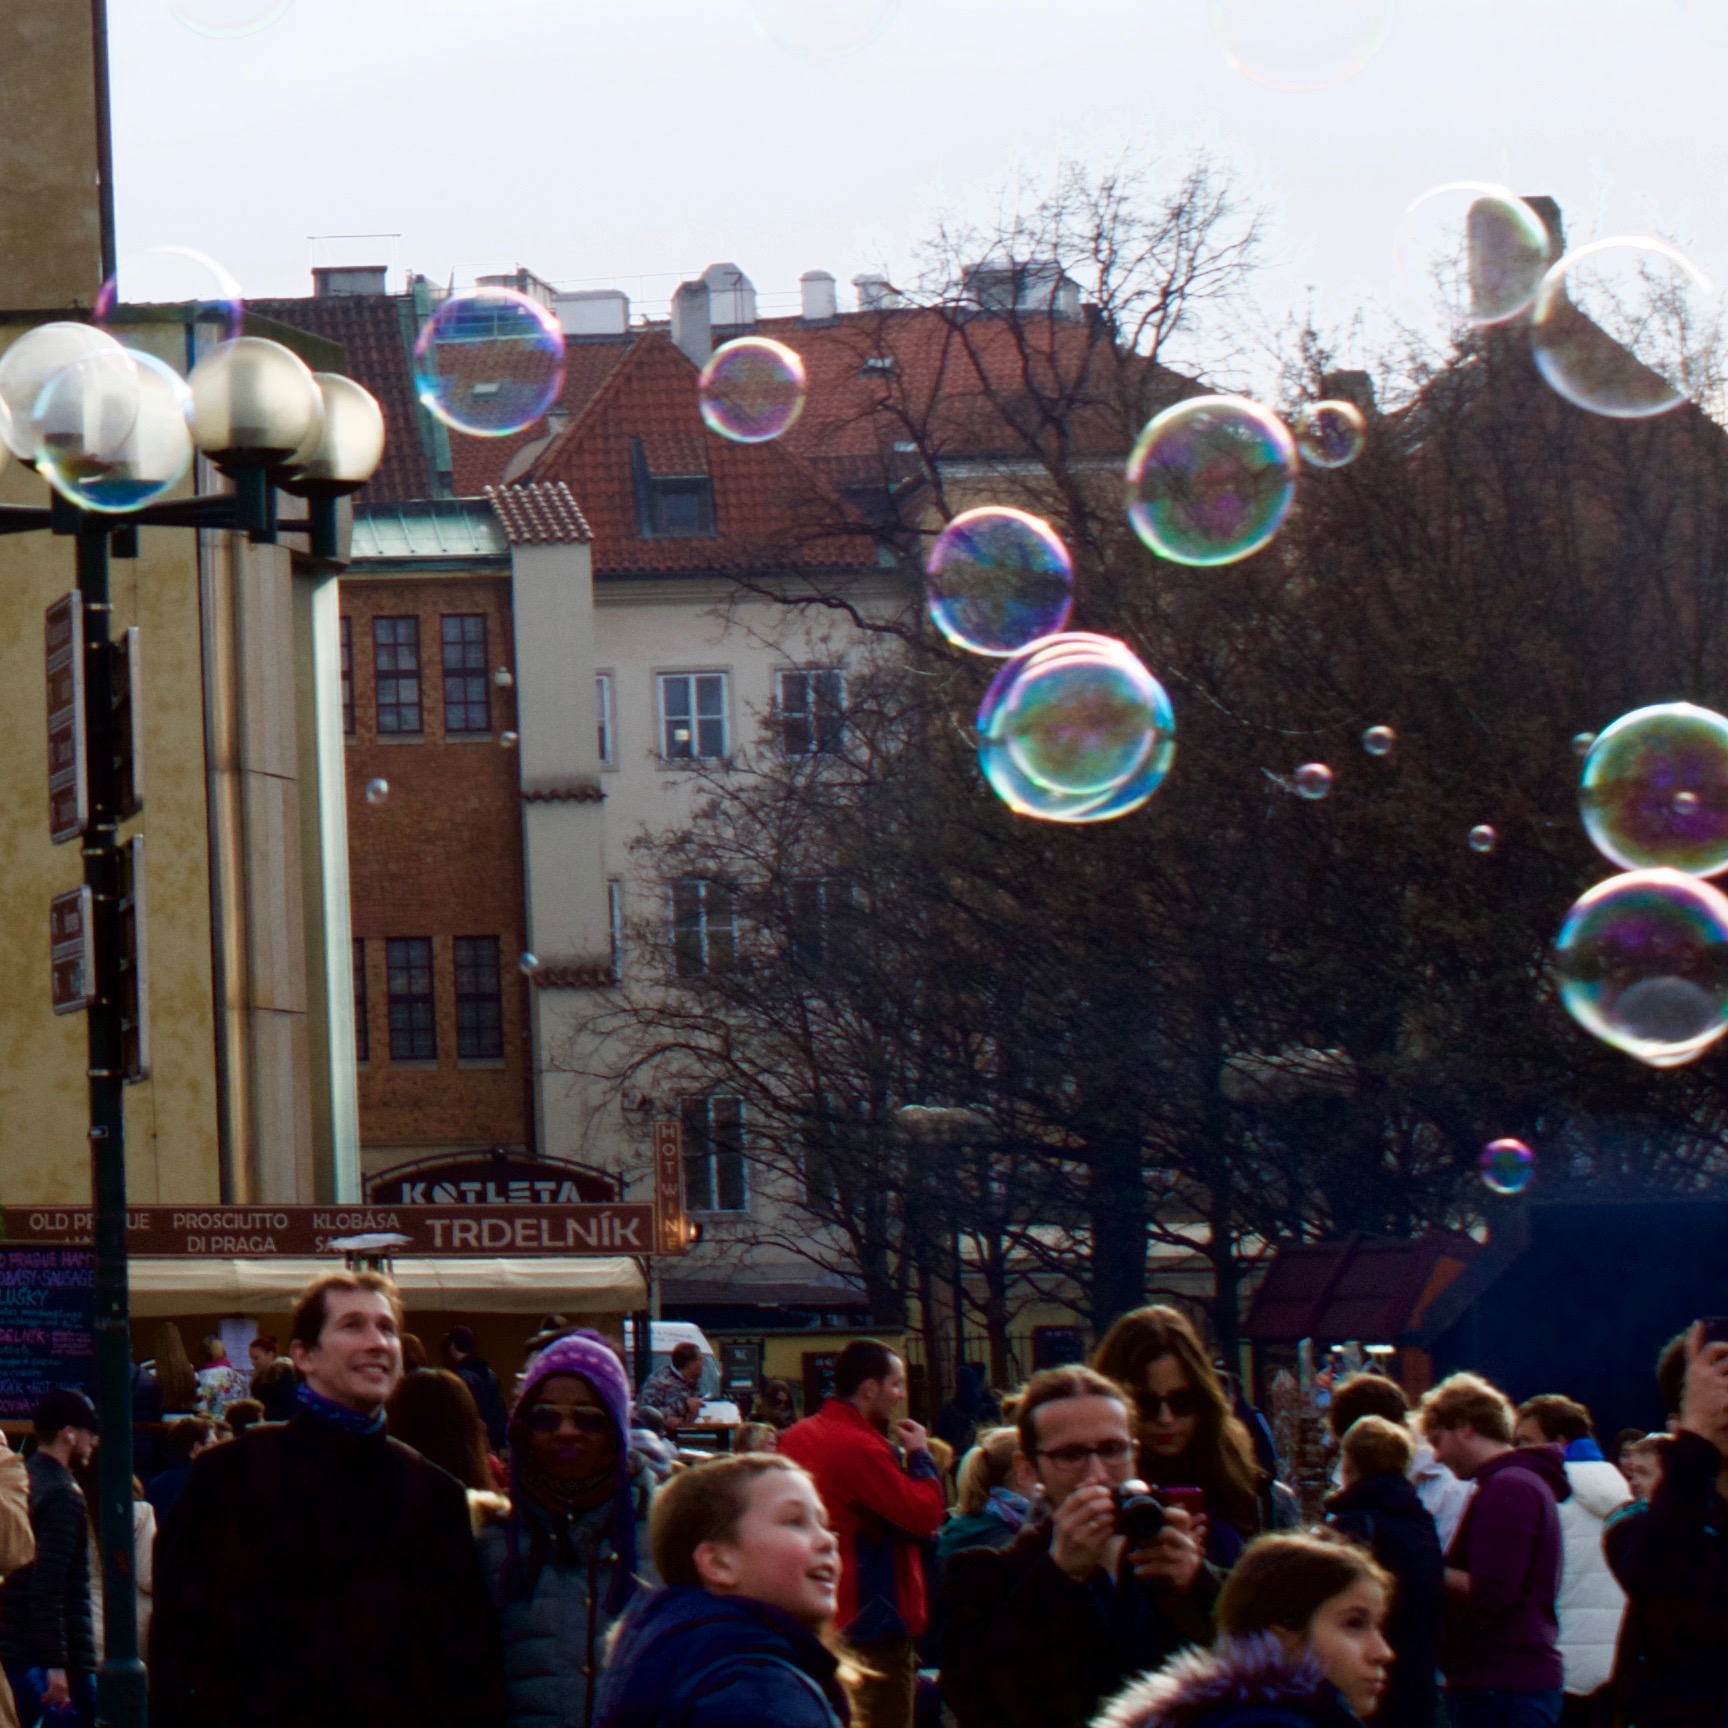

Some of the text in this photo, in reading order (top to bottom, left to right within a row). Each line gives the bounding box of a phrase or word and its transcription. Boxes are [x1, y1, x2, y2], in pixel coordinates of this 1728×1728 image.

[402, 1181, 582, 1203] KOTLETA
[662, 1126, 679, 1250] HOT WINE
[29, 1213, 69, 1231] OLD
[173, 1213, 288, 1229] PROSCIUTTO
[313, 1209, 399, 1229] KLOBÁSA
[425, 1211, 641, 1248] TRDELNÍK
[187, 1236, 277, 1252] DI PRAGA
